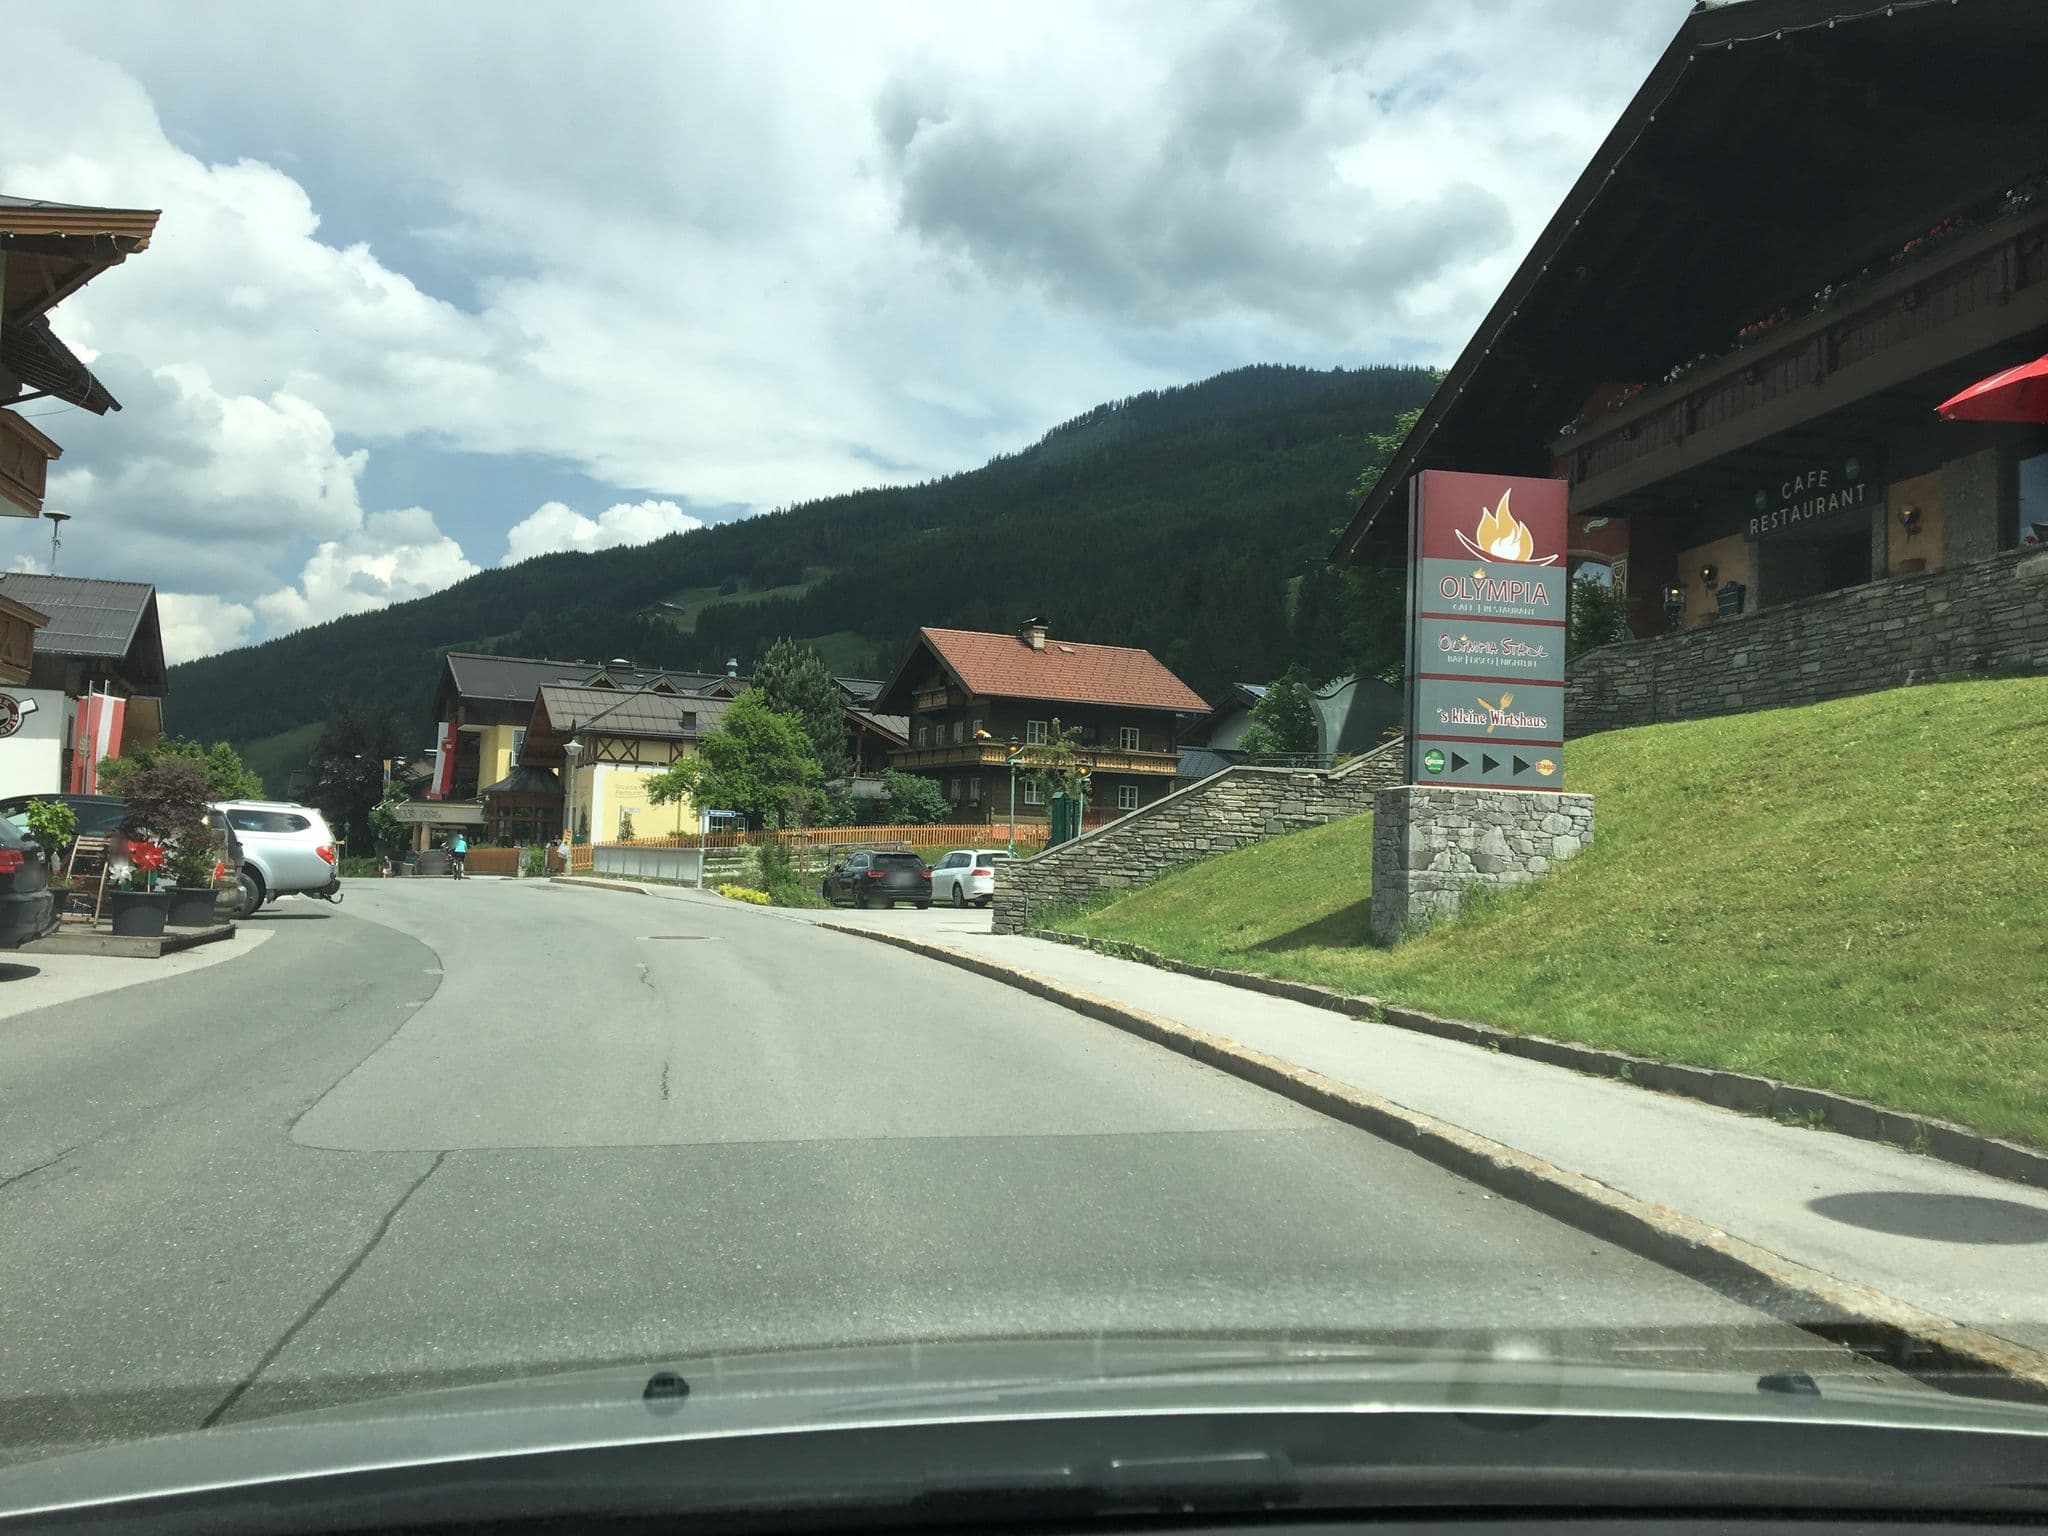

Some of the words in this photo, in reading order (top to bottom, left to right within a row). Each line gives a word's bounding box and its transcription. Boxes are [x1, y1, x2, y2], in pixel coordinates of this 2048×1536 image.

[1782, 470, 1829, 499] CAFE
[1750, 483, 1865, 535] RESTAURANT
[1439, 575, 1549, 605] OLYMPIA
[1483, 605, 1535, 616] RESTAURANT
[1447, 655, 1464, 663] BAR
[1469, 657, 1494, 665] DISCO
[1451, 707, 1487, 725] kleine
[1489, 709, 1548, 729] Wirtshaus
